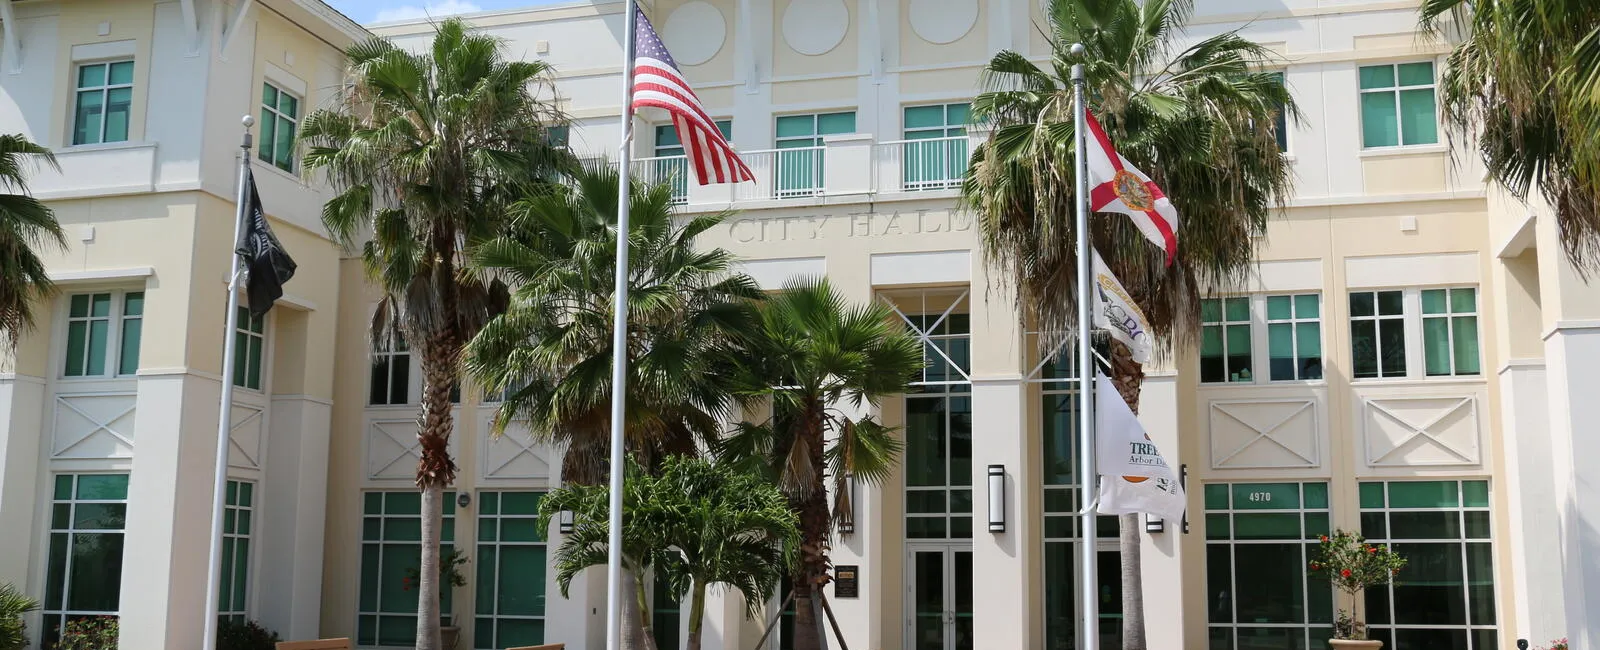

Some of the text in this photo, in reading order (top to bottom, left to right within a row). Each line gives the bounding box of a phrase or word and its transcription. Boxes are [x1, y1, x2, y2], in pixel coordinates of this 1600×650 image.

[729, 207, 973, 243] CITY HALL
[1129, 455, 1153, 464] Arbor
[1249, 492, 1271, 502] 4970
